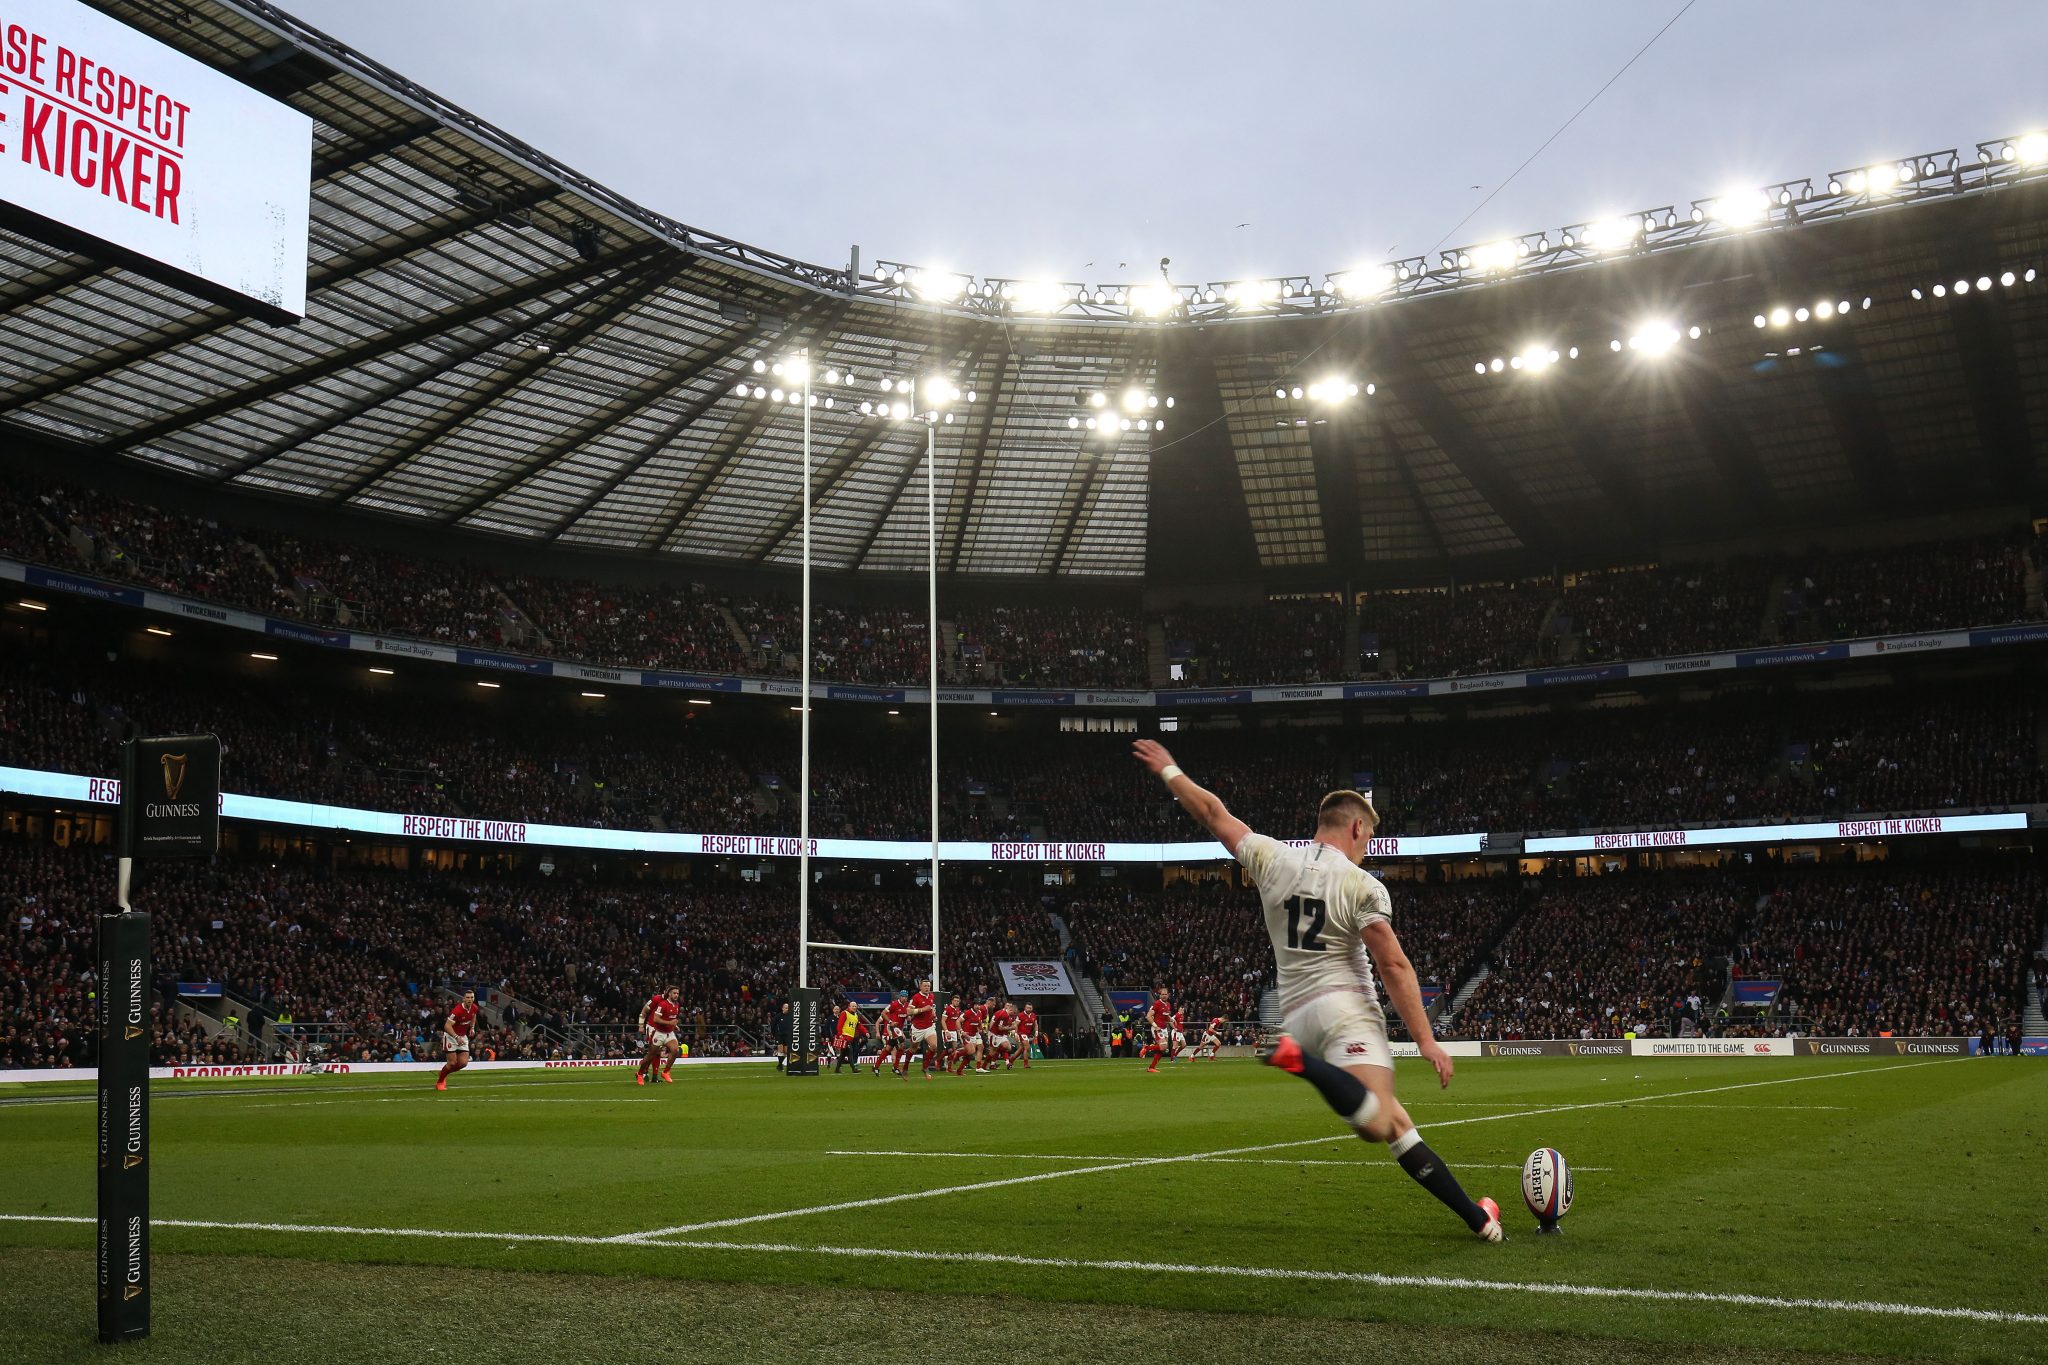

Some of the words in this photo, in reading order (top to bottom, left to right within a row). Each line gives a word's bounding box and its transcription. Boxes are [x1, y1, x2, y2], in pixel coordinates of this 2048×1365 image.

[55, 46, 191, 148] RESPECT
[21, 95, 182, 225] KICKER
[46, 578, 78, 591] BRITISH
[79, 585, 111, 599] AIRWAYS
[182, 603, 227, 621] TWICKENHAM
[1887, 641, 1917, 650] England
[1918, 639, 1942, 648] Rugby
[1991, 634, 2022, 644] BRITISH
[385, 642, 412, 654] England
[413, 645, 434, 657] Rugby
[474, 658, 500, 668] BRITISH
[500, 661, 527, 671] AIRWAYS
[1664, 659, 1711, 671] TWICKENHAM
[1755, 656, 1784, 665] BRITISH
[1784, 653, 1815, 662] AIRWAYS
[580, 668, 621, 681] TWICKENHAM
[658, 679, 683, 688] BRITISH
[769, 684, 794, 694] England
[1459, 682, 1484, 690] England
[1485, 680, 1504, 688] Rugby
[937, 693, 975, 701] WICKENHAM
[1095, 696, 1120, 704] England
[1120, 696, 1140, 704] Rugby
[1280, 690, 1323, 698] TWICKENHAM
[146, 803, 200, 818] GUINNESS
[403, 815, 458, 838] RESPECT
[459, 820, 481, 839] THE
[484, 821, 526, 842] KICKER
[1838, 821, 1882, 837] RESPECT
[1884, 820, 1903, 834] THE
[1904, 818, 1942, 833] KICKER
[701, 835, 752, 853] RESPECT
[754, 837, 775, 855] THE
[777, 838, 818, 856] KICKR
[1366, 838, 1399, 855] CKER
[1594, 834, 1633, 849] RESPECT
[1635, 833, 1651, 847] THE
[1652, 831, 1686, 845] KICKER
[991, 843, 1040, 860] RESPECT
[1043, 843, 1063, 860] THE
[1065, 843, 1106, 860] KICKER
[1283, 895, 1327, 951] 12
[128, 958, 141, 1024] GUINNESS
[791, 1001, 800, 1052] GUINNESS
[808, 1001, 817, 1052] GUINNESS
[1389, 1047, 1418, 1056] England
[1500, 1046, 1542, 1055] GUINNESS
[1579, 1045, 1623, 1055] GUINNESS
[1653, 1043, 1695, 1054] COMMITTED
[1696, 1043, 1706, 1053] TO
[1709, 1043, 1722, 1053] THE
[1724, 1043, 1745, 1053] GAME
[1820, 1043, 1870, 1053] GUINNESS
[1907, 1043, 1959, 1053] GUINNESS
[127, 1086, 141, 1152] GUINNESS
[1531, 1150, 1545, 1205] GILBERT
[127, 1216, 140, 1283] GUINNESS
